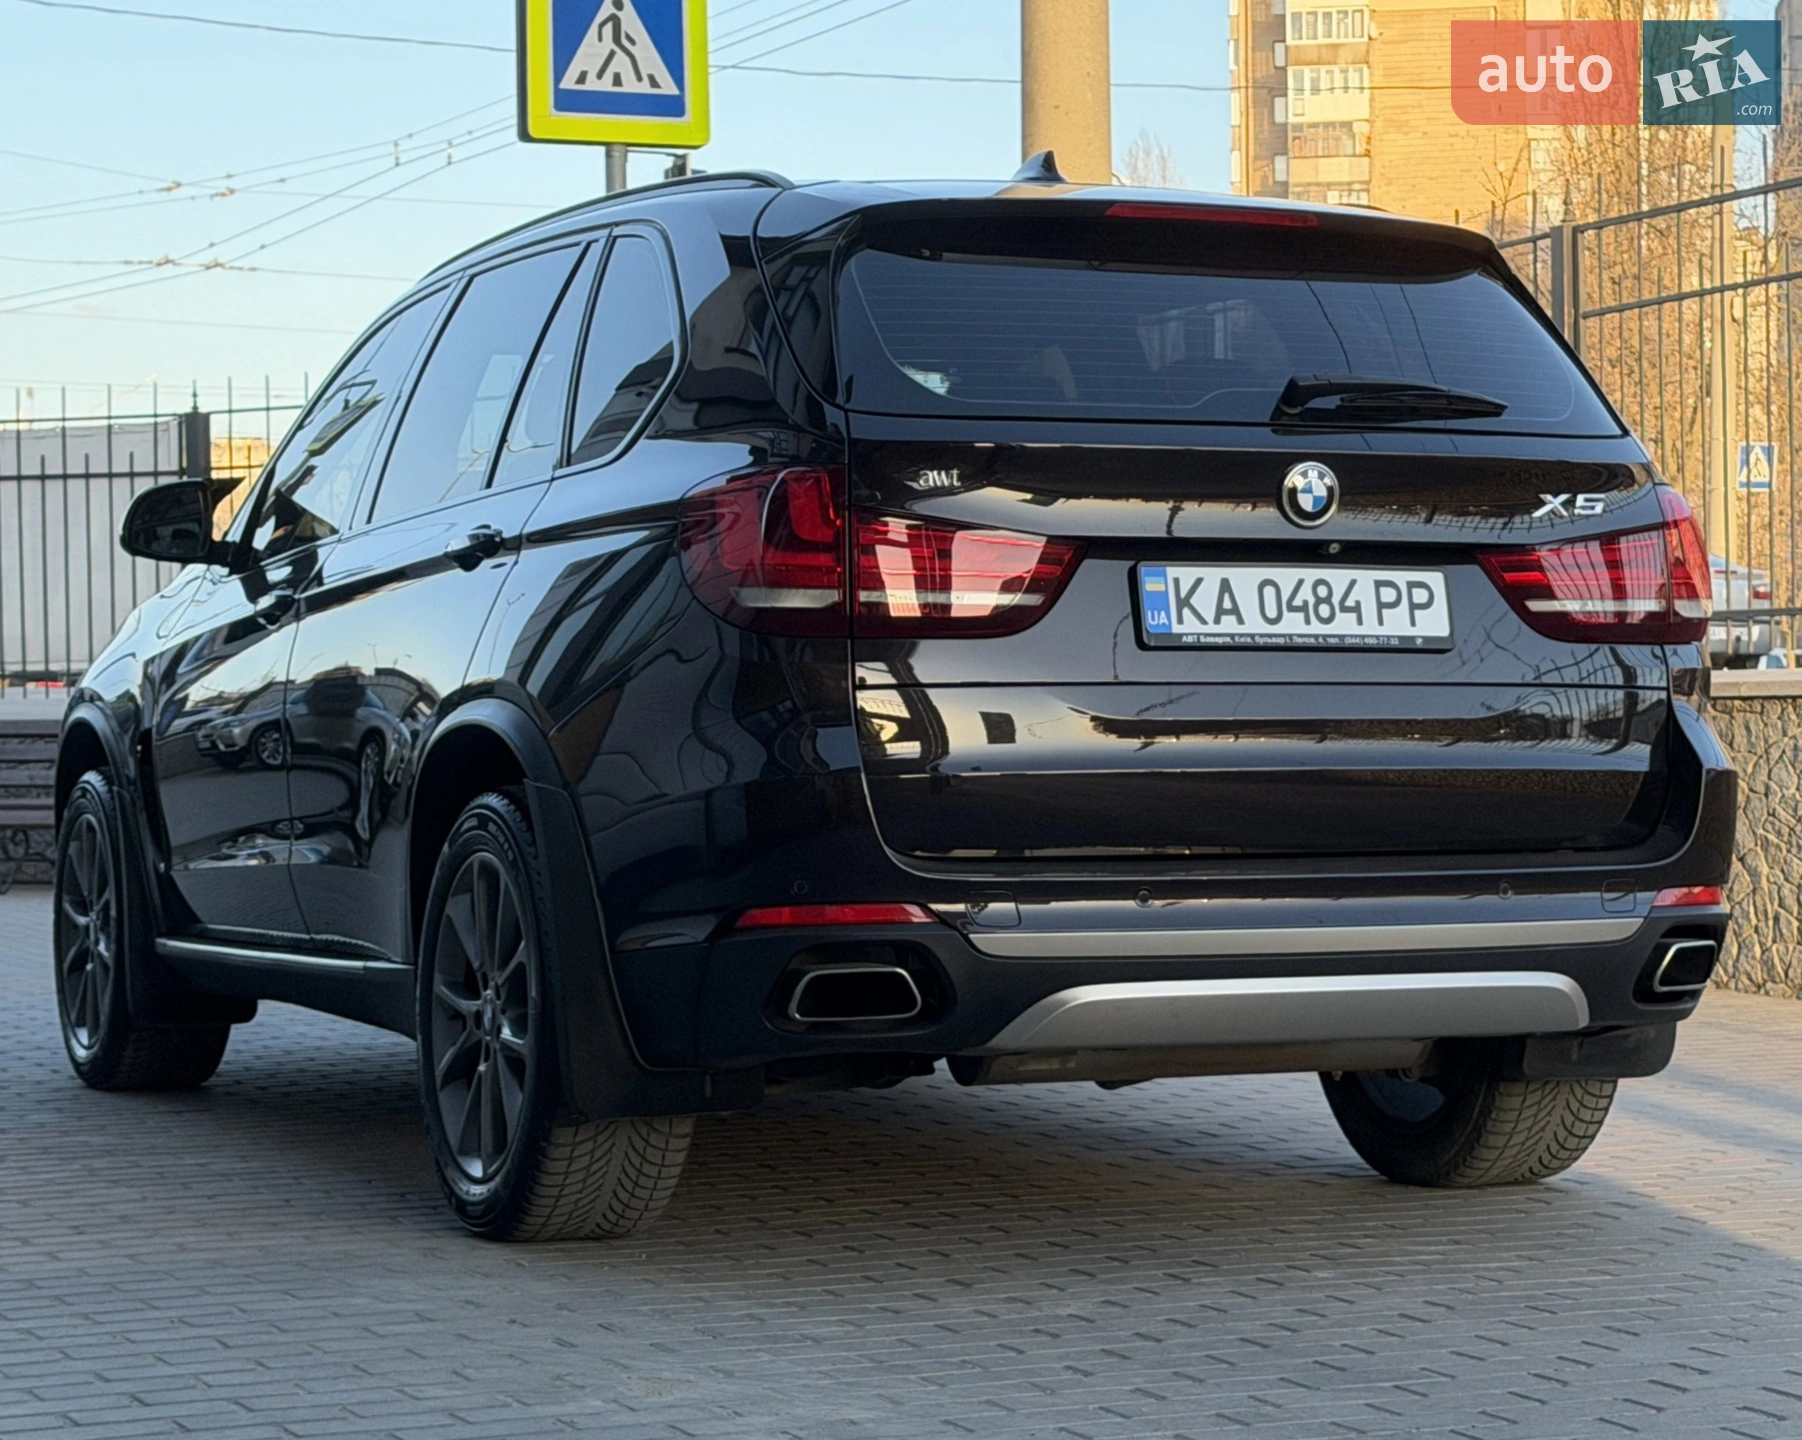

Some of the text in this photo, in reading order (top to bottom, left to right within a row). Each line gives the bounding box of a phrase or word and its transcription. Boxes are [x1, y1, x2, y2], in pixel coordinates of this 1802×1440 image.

[1531, 493, 1606, 517] X5
[1172, 576, 1435, 628] KA 0484 PP
[1147, 610, 1169, 626] UA
